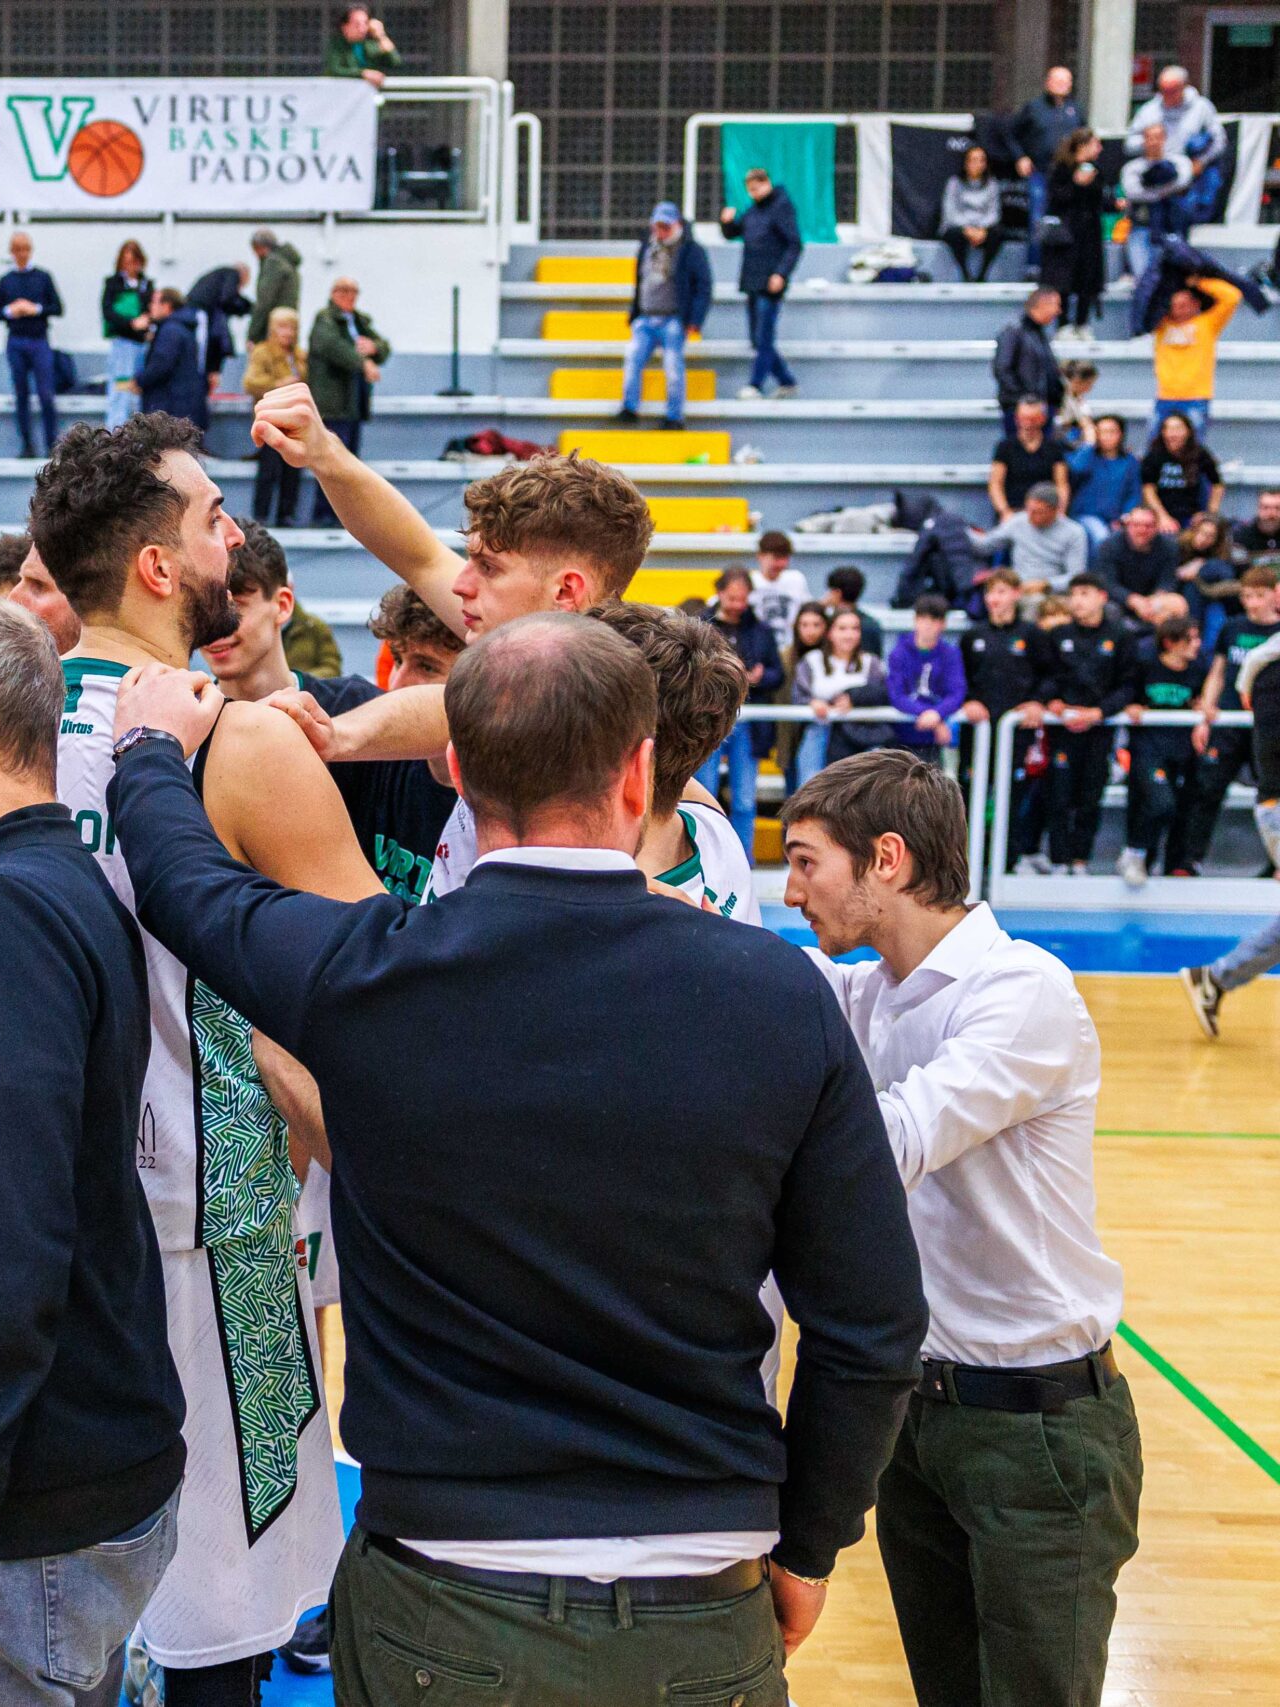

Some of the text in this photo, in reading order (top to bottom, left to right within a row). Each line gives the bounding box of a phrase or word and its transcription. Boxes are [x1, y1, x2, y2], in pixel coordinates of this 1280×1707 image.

[133, 95, 299, 126] VIRTUS
[169, 126, 324, 151] BASKET
[188, 154, 363, 184] PADOVA
